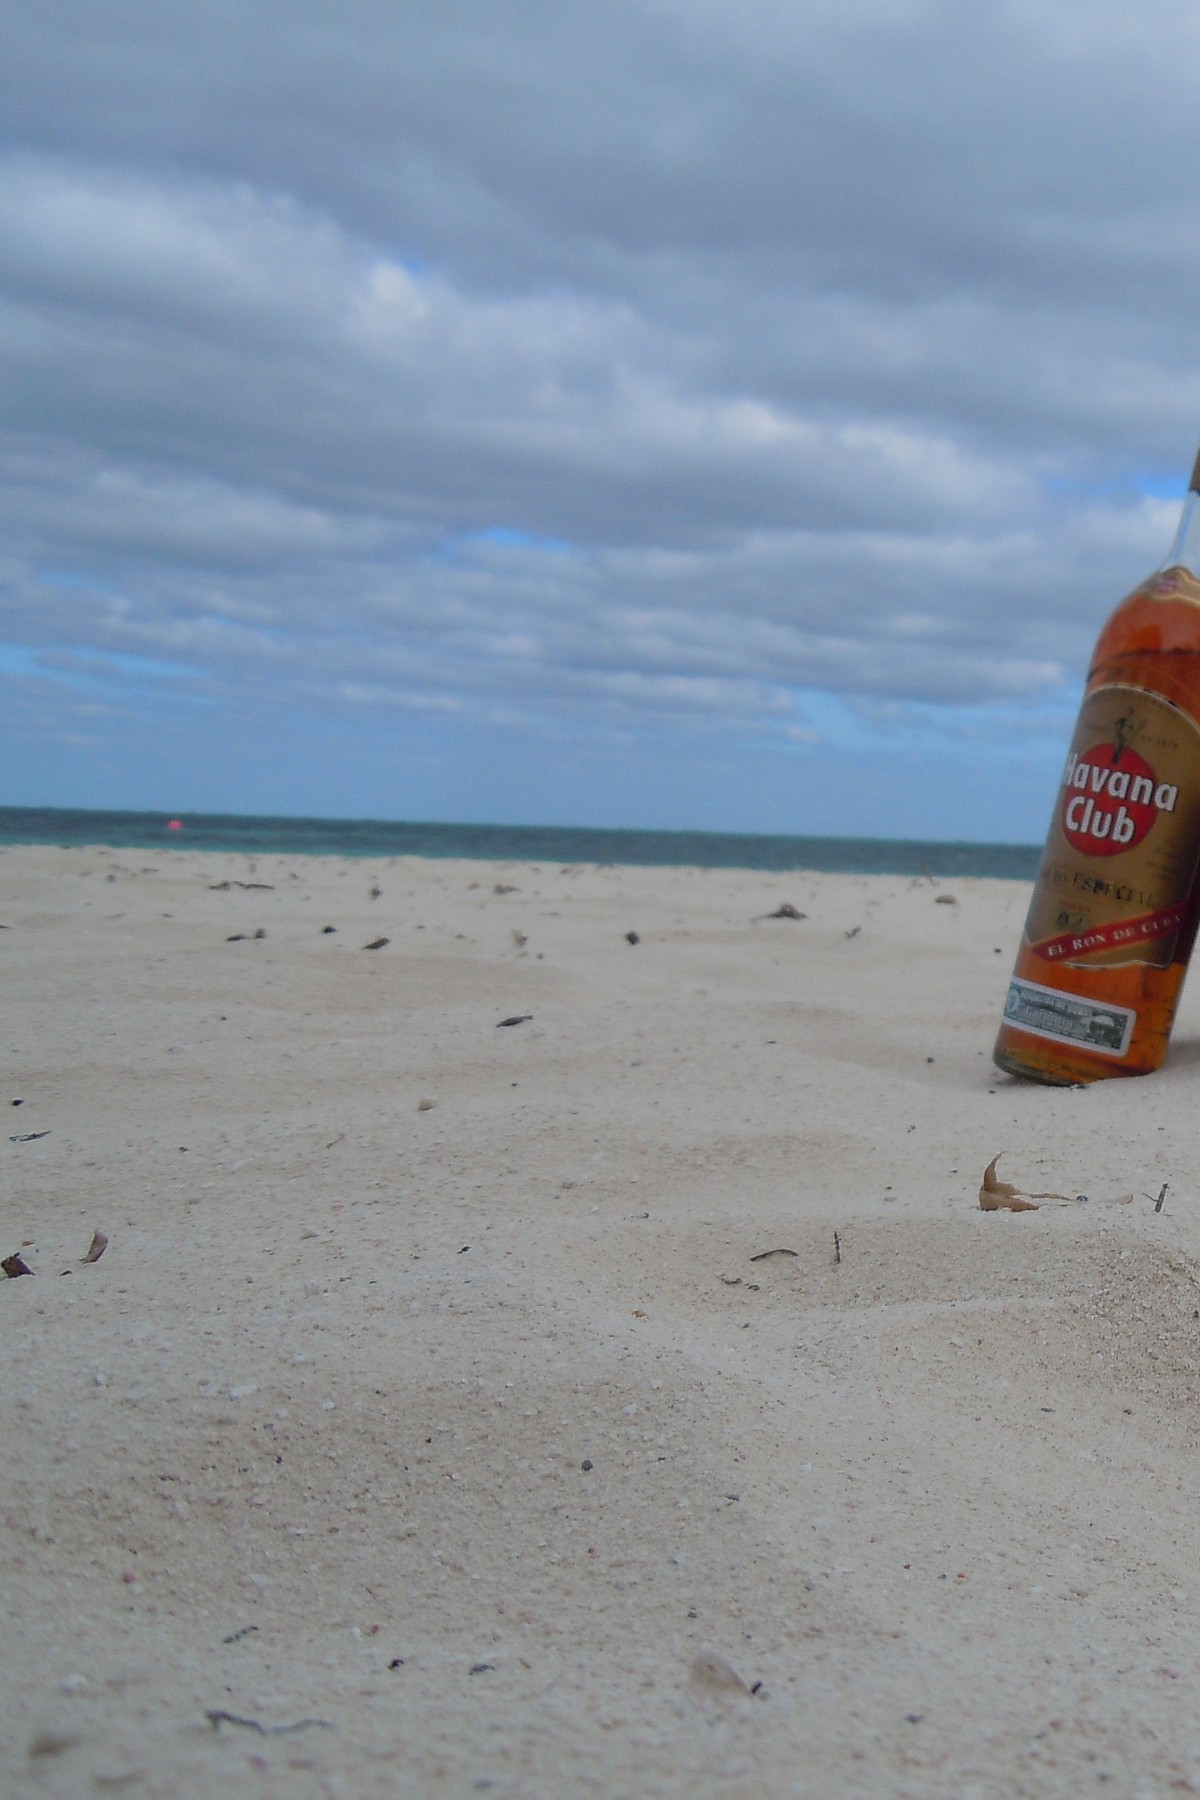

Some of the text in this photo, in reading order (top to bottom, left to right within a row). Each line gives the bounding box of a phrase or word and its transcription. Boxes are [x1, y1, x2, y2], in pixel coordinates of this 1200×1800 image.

[1065, 753, 1178, 811] Havana
[1065, 796, 1134, 843] Club
[1113, 927, 1136, 941] DE
